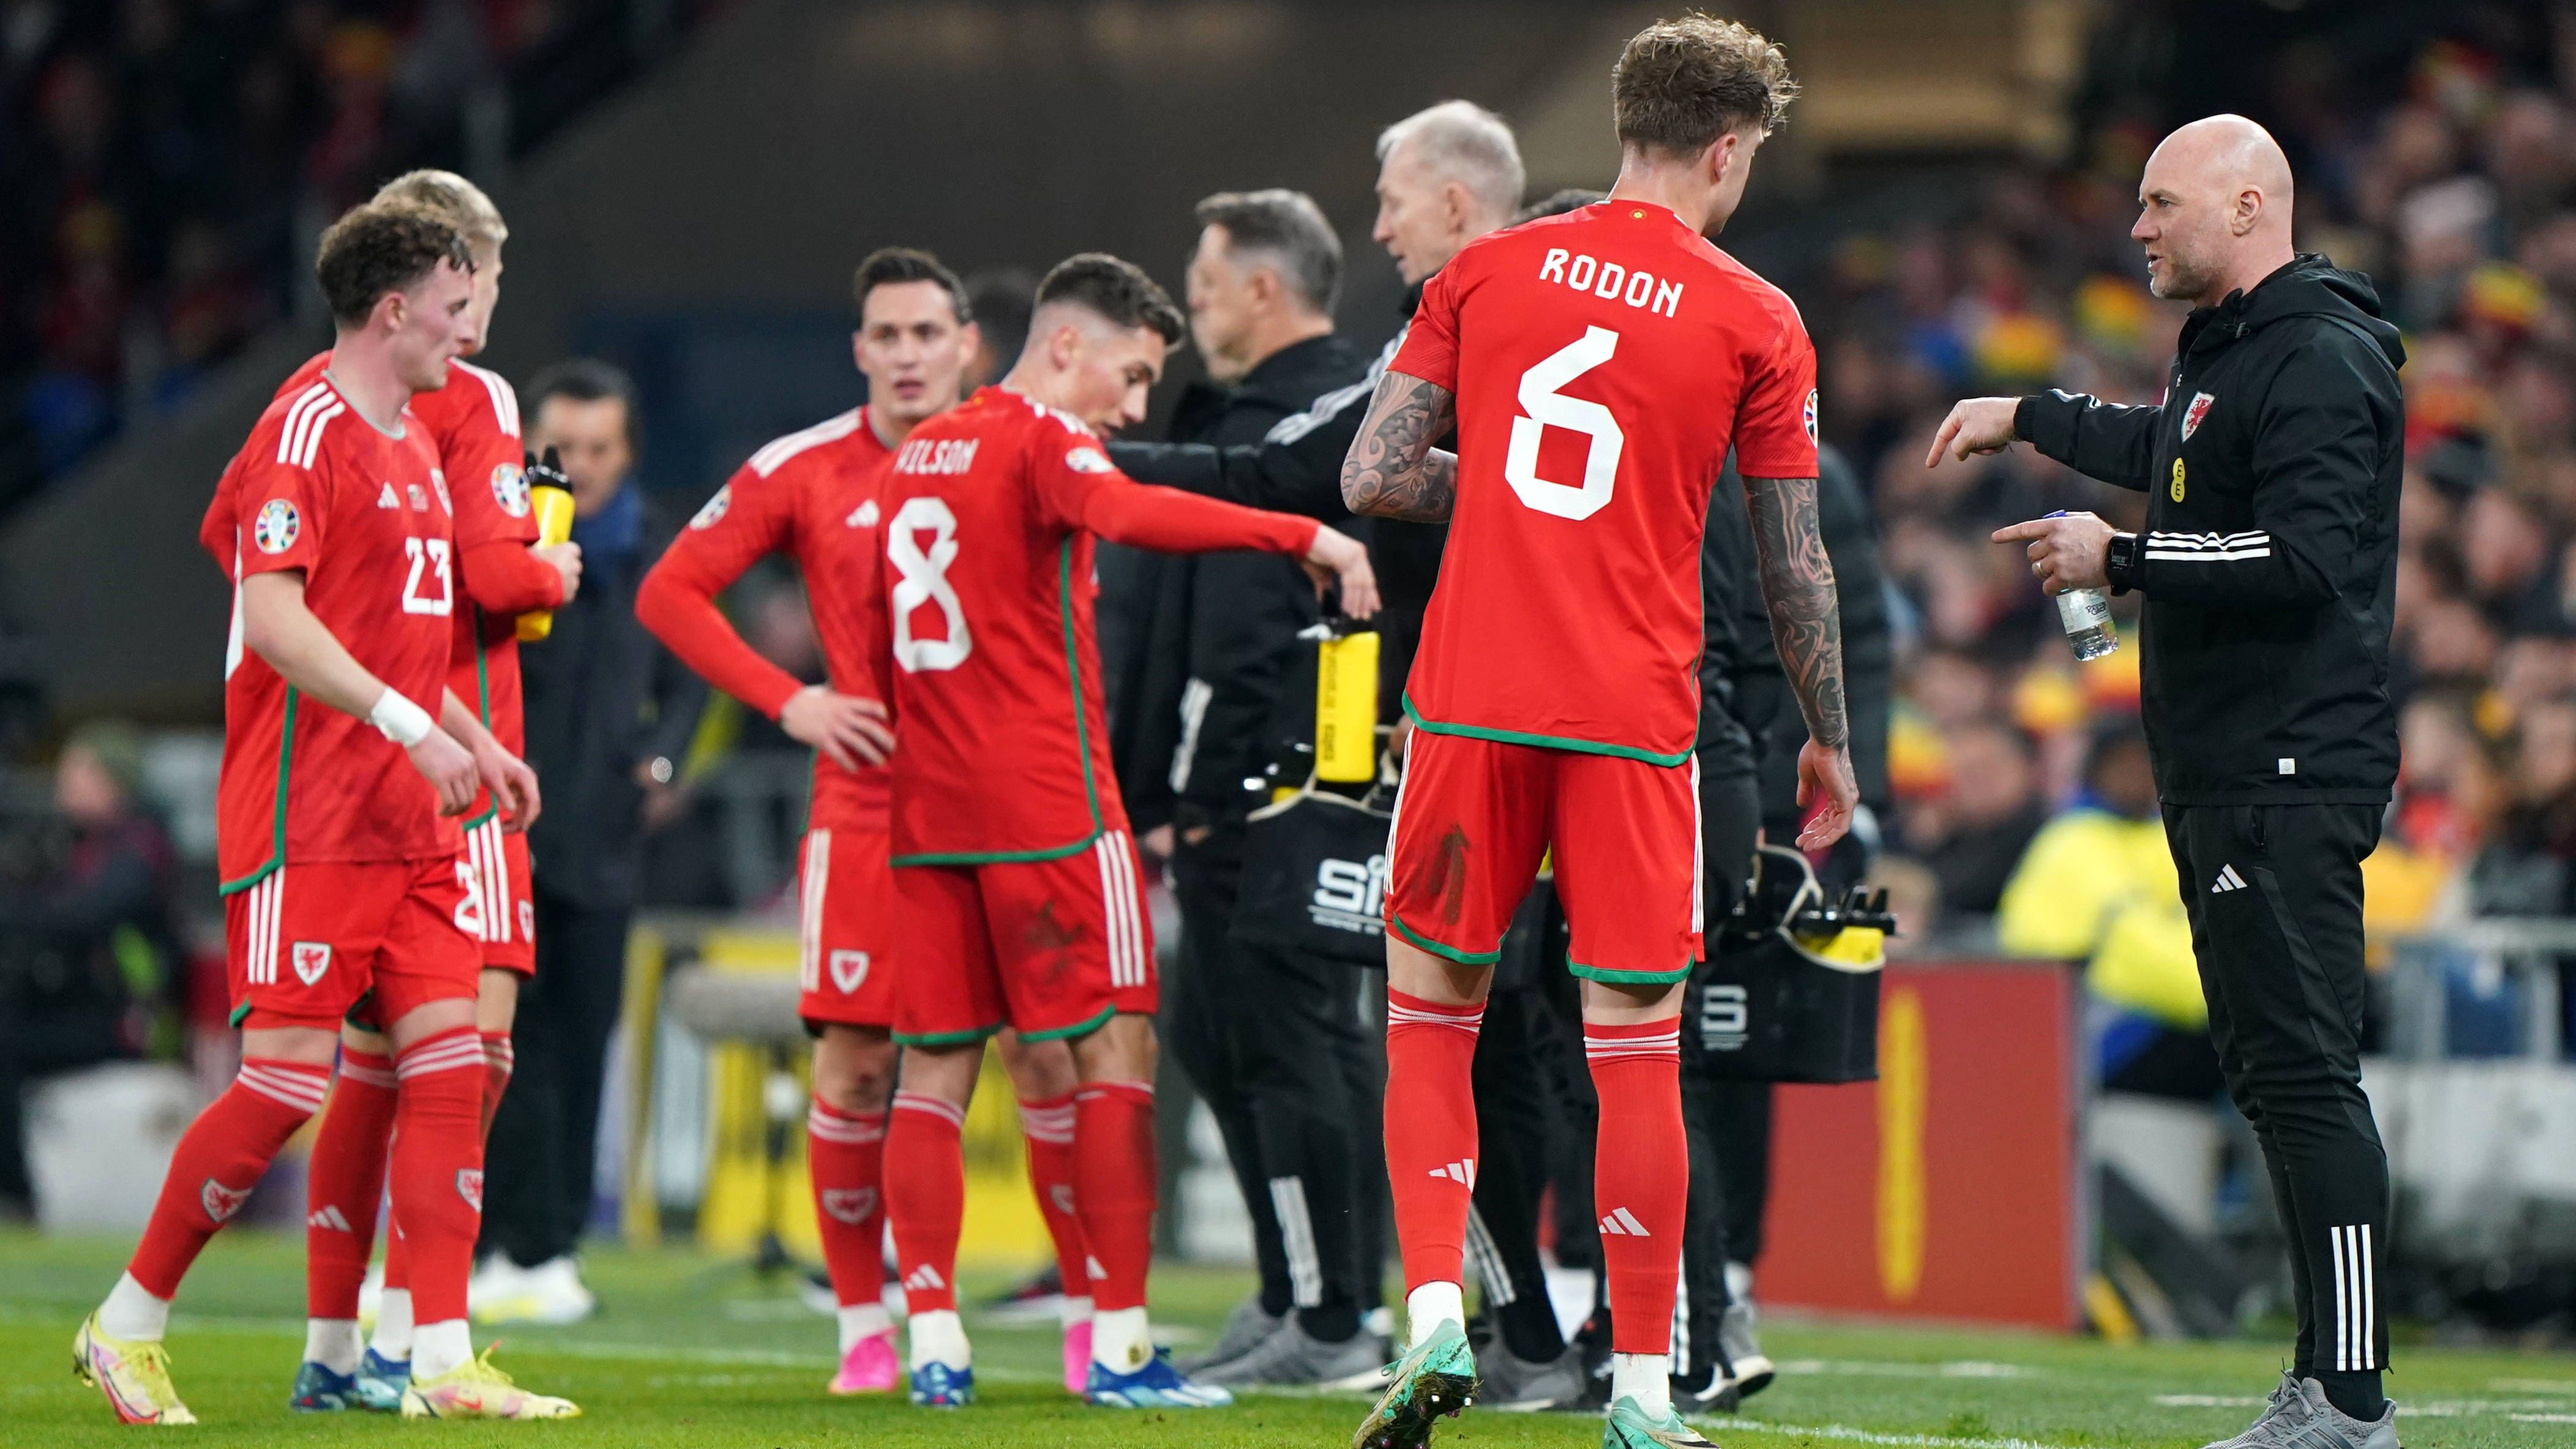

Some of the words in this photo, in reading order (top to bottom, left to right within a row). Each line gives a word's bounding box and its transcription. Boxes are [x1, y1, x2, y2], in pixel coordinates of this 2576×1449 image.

[1539, 248, 1683, 318] RODON
[1505, 324, 1624, 521] 6
[402, 536, 454, 616] 23
[888, 496, 972, 673] 8
